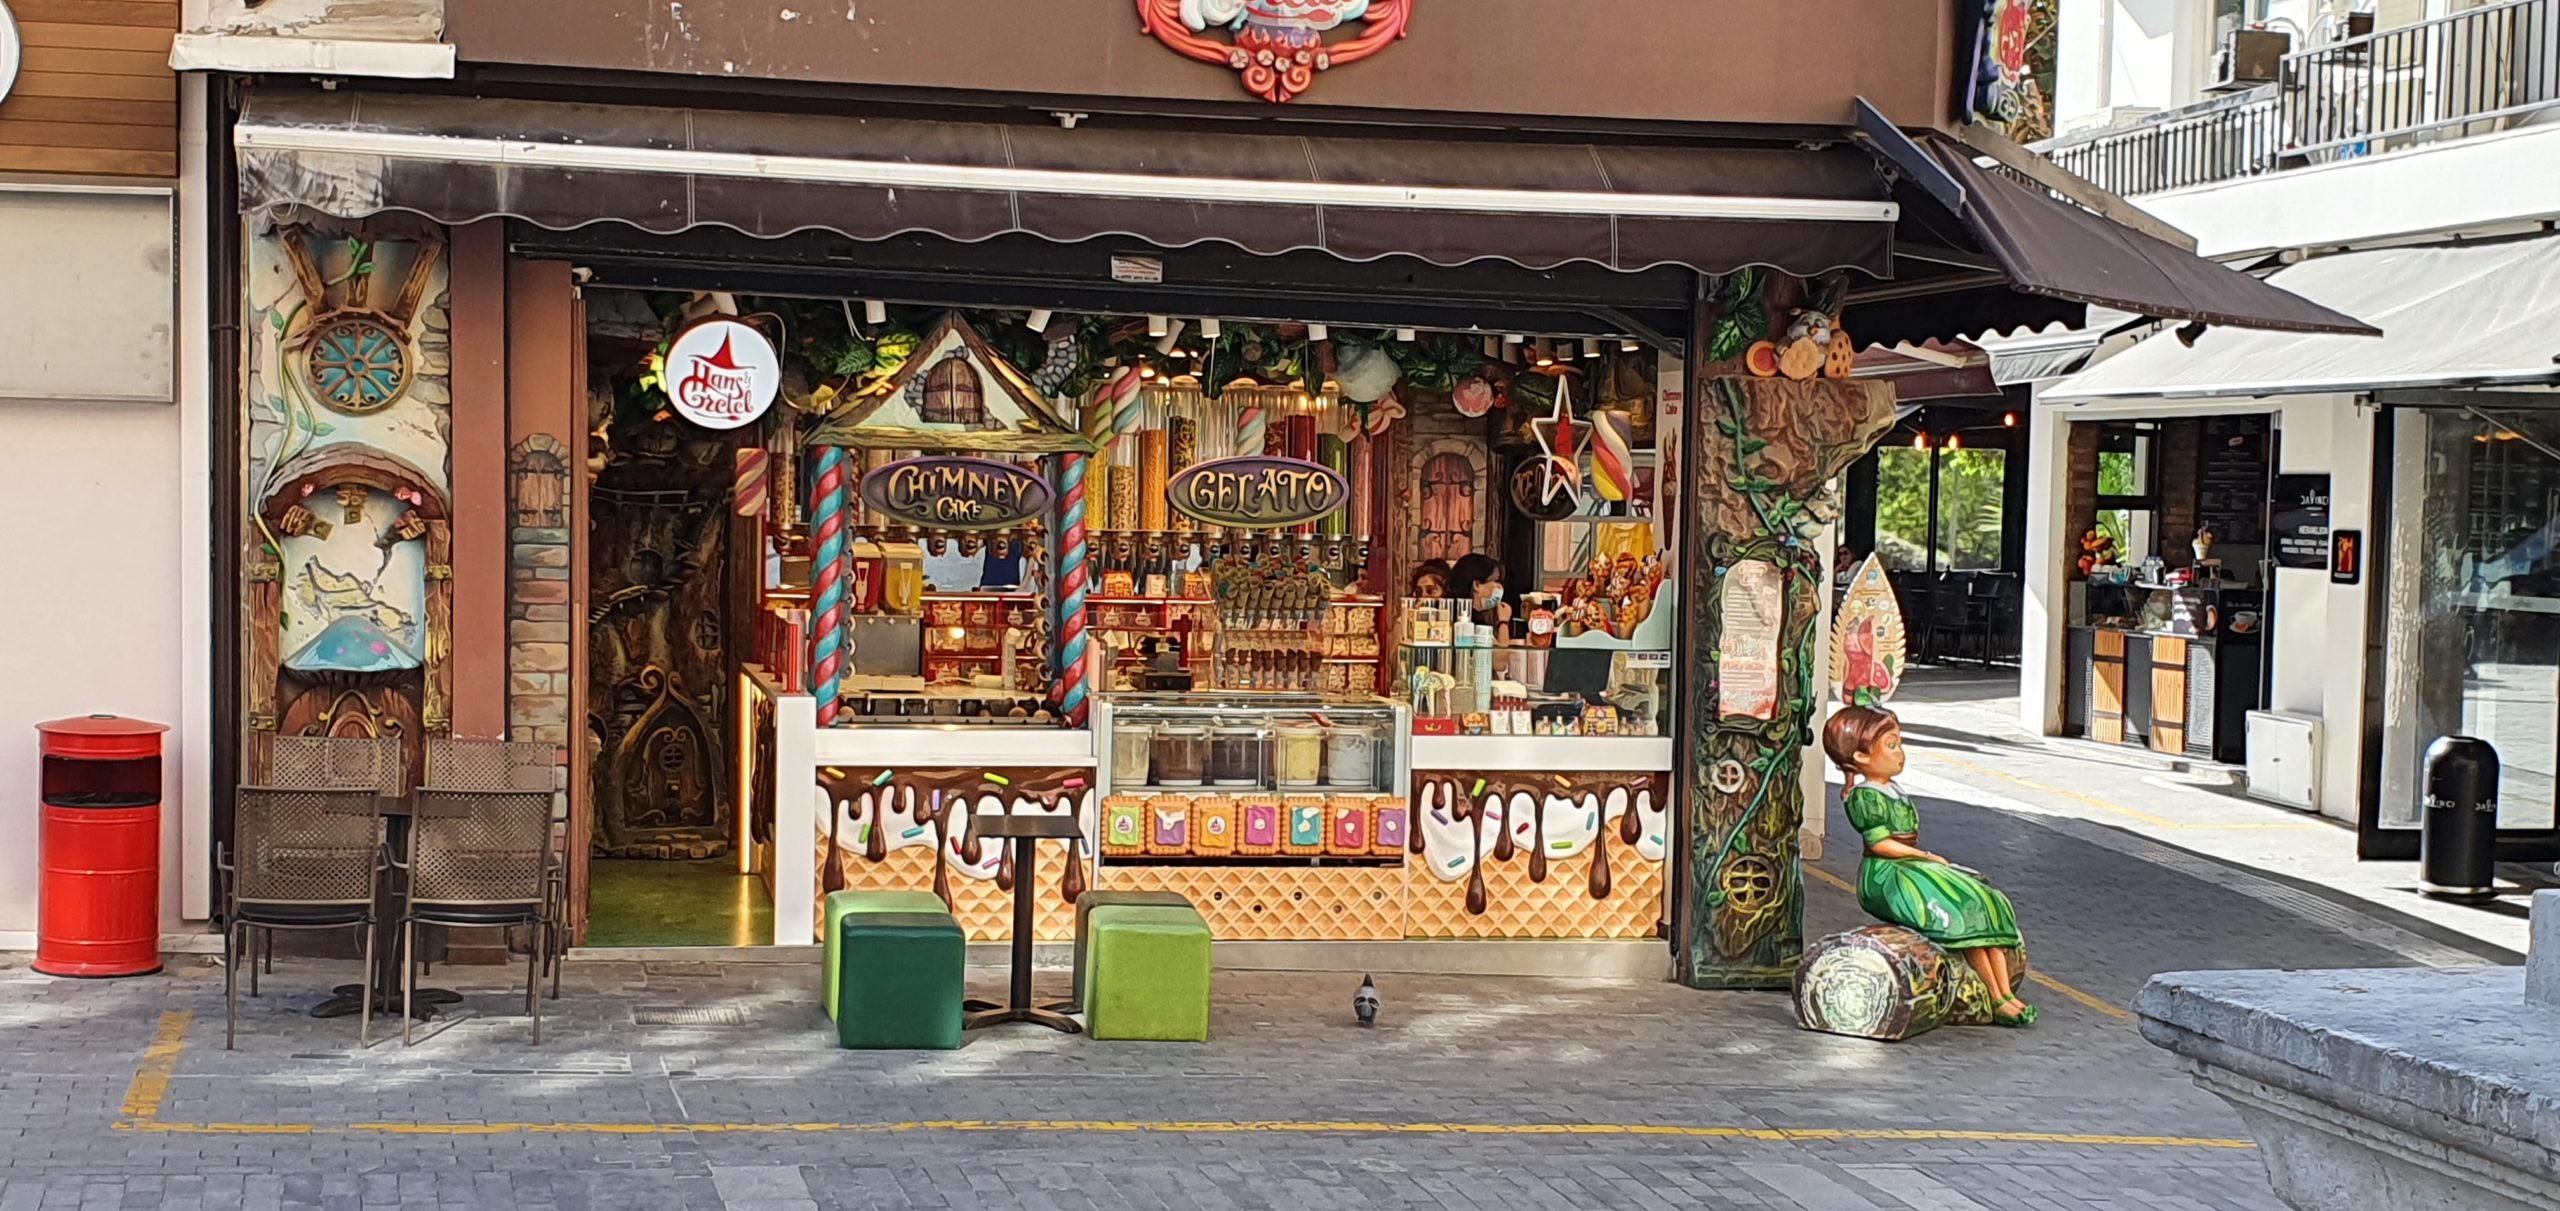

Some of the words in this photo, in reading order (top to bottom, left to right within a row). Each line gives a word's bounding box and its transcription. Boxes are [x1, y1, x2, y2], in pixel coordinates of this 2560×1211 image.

[690, 359, 743, 397] Hans
[679, 385, 755, 414] Gretel
[936, 497, 982, 522] CAKE
[1189, 468, 1333, 518] GELATO
